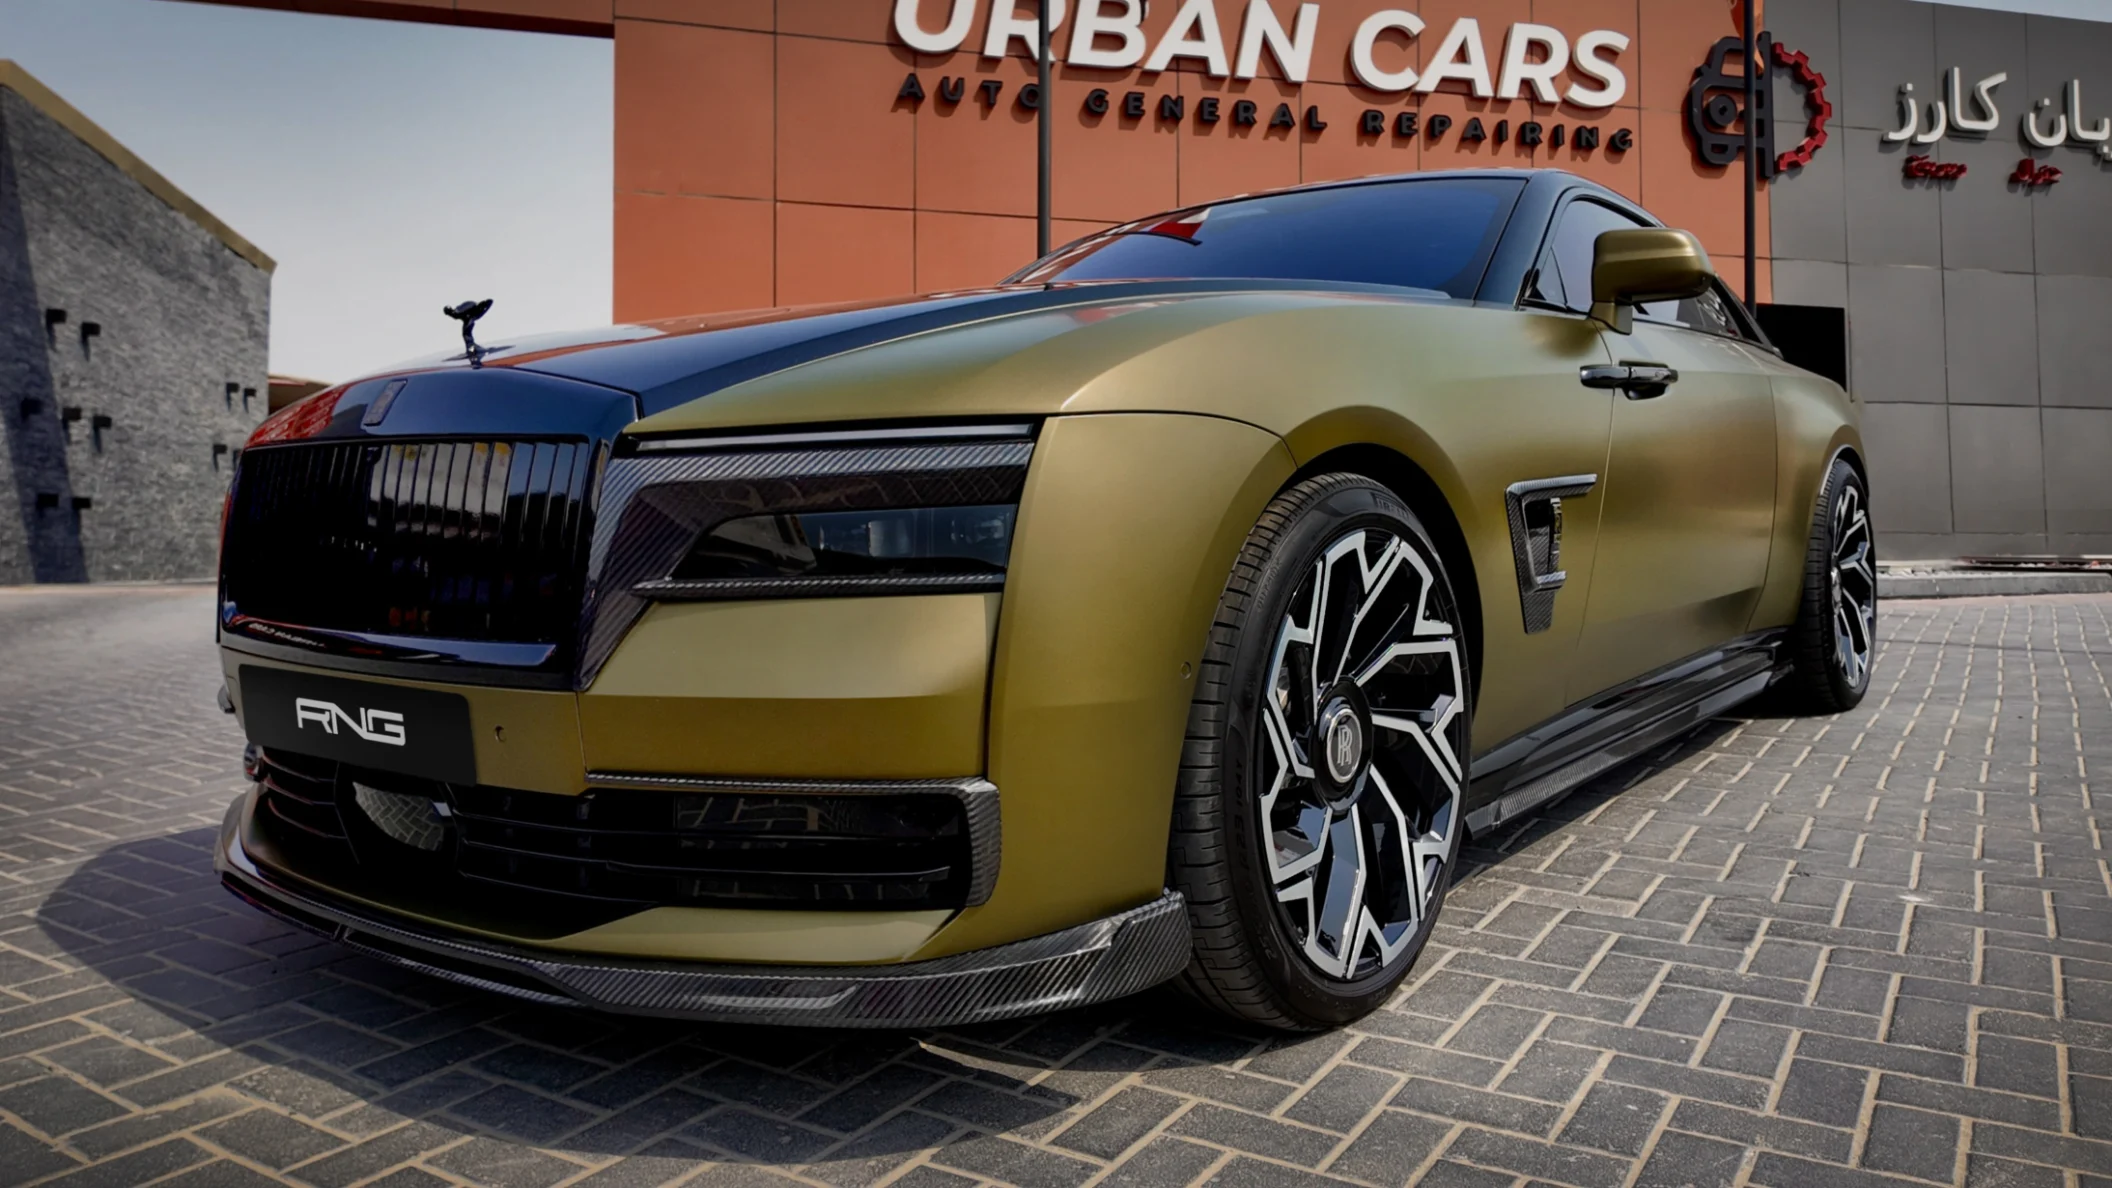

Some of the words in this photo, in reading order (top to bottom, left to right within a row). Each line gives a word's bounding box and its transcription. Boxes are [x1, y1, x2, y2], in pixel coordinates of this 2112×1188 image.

[894, 0, 1320, 83] URBAN
[1351, 9, 1630, 109] CARS
[899, 72, 1041, 109] AUTO
[1086, 88, 1328, 130] GENERAL
[1363, 109, 1634, 151] REPAIRING
[295, 697, 406, 747] RNG
